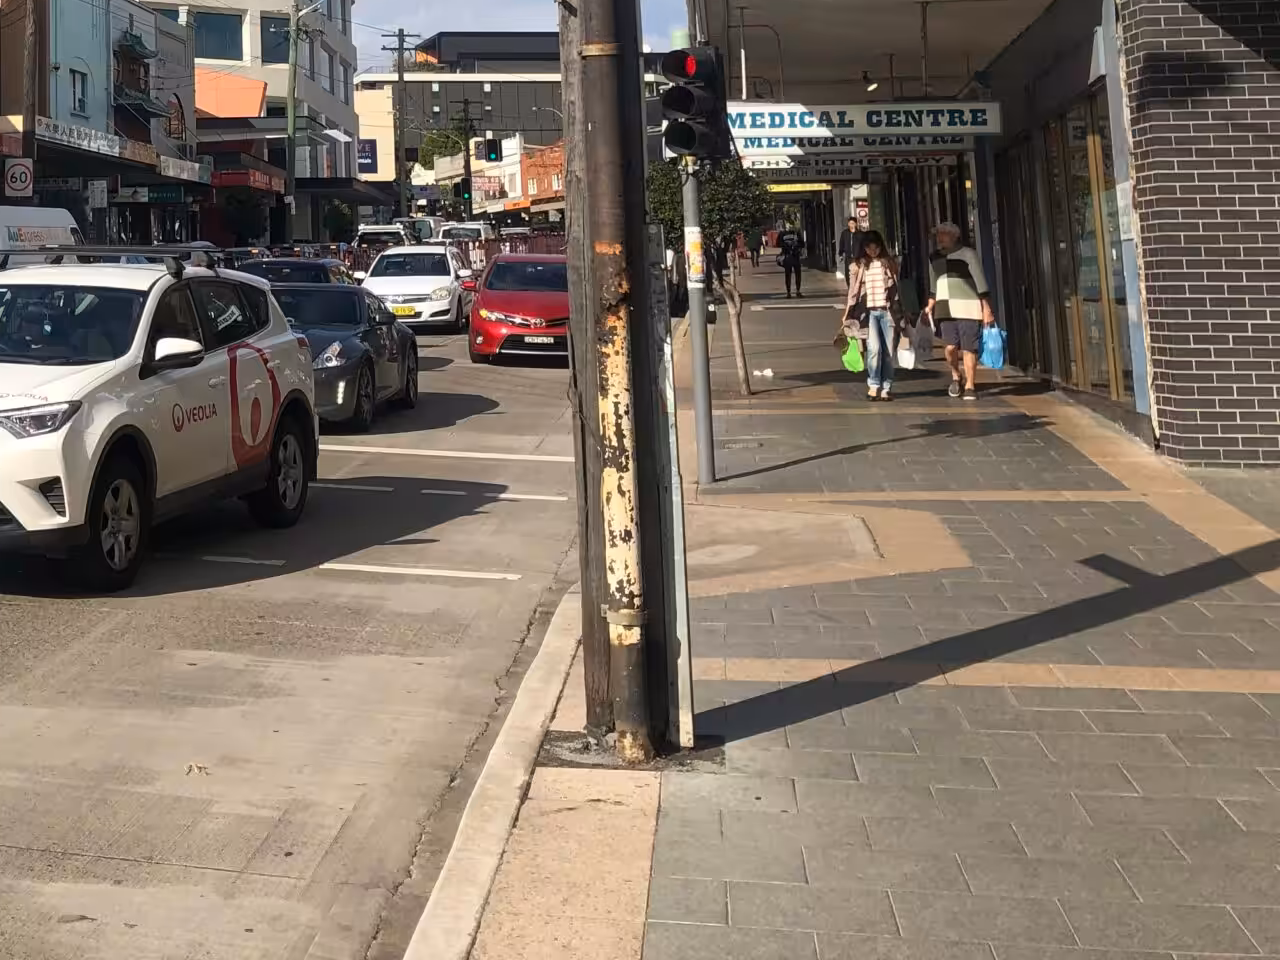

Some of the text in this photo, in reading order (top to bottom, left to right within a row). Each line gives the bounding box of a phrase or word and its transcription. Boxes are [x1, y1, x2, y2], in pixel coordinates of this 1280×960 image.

[727, 108, 989, 129] MEDICAL CENTRE
[751, 157, 945, 168] PHYSIOTHERAPY
[10, 171, 28, 184] 60
[185, 403, 218, 425] VEOLIA
